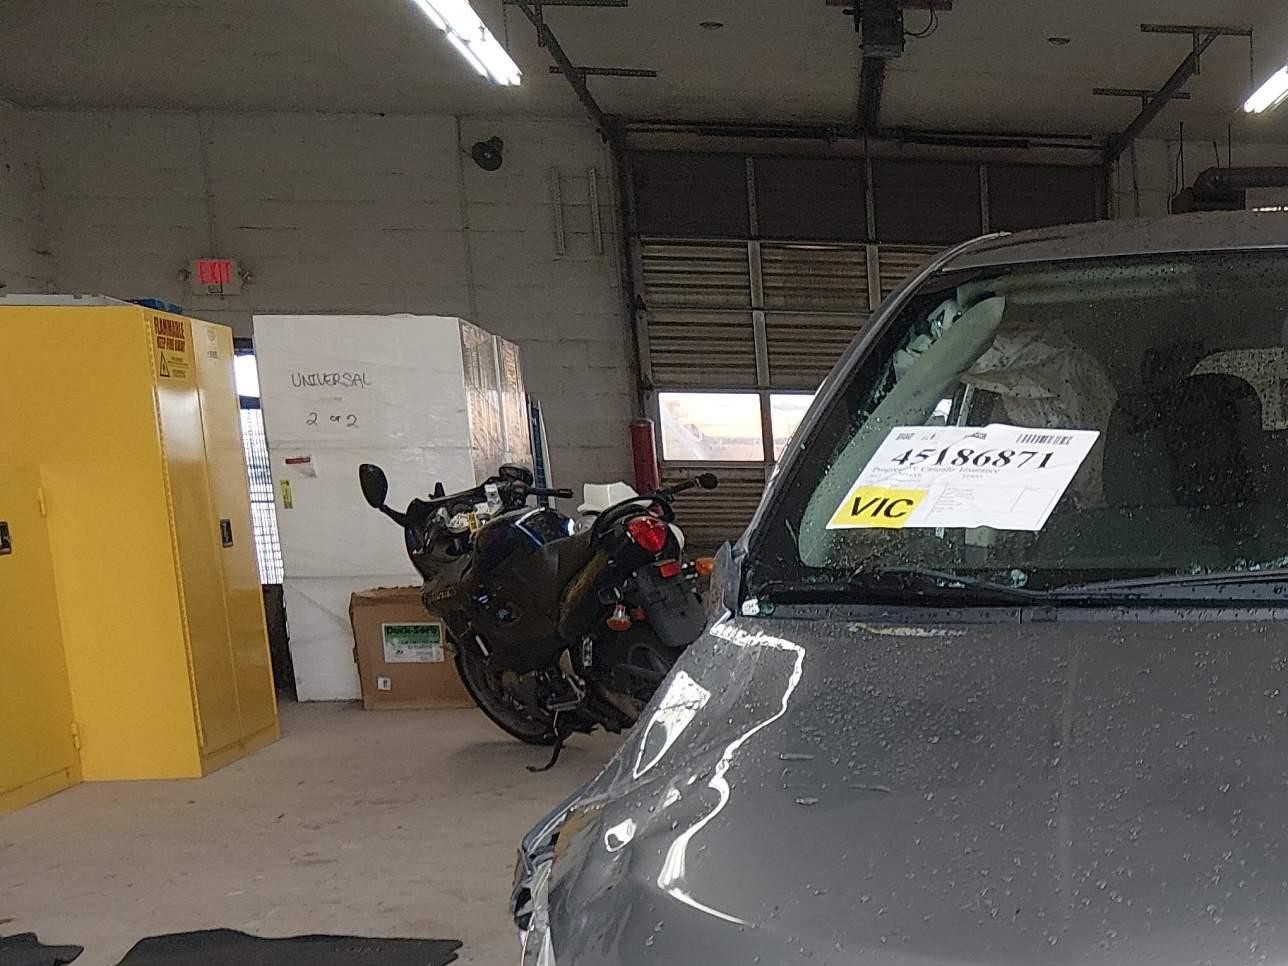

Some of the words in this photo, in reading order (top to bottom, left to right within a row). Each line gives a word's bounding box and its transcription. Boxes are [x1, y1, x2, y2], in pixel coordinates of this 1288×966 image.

[198, 261, 231, 284] EXIT
[291, 372, 372, 389] UNIVERSAL
[306, 412, 318, 426] 2
[346, 414, 360, 428] 2
[891, 446, 1055, 470] 45186871
[850, 496, 914, 518] VIC
